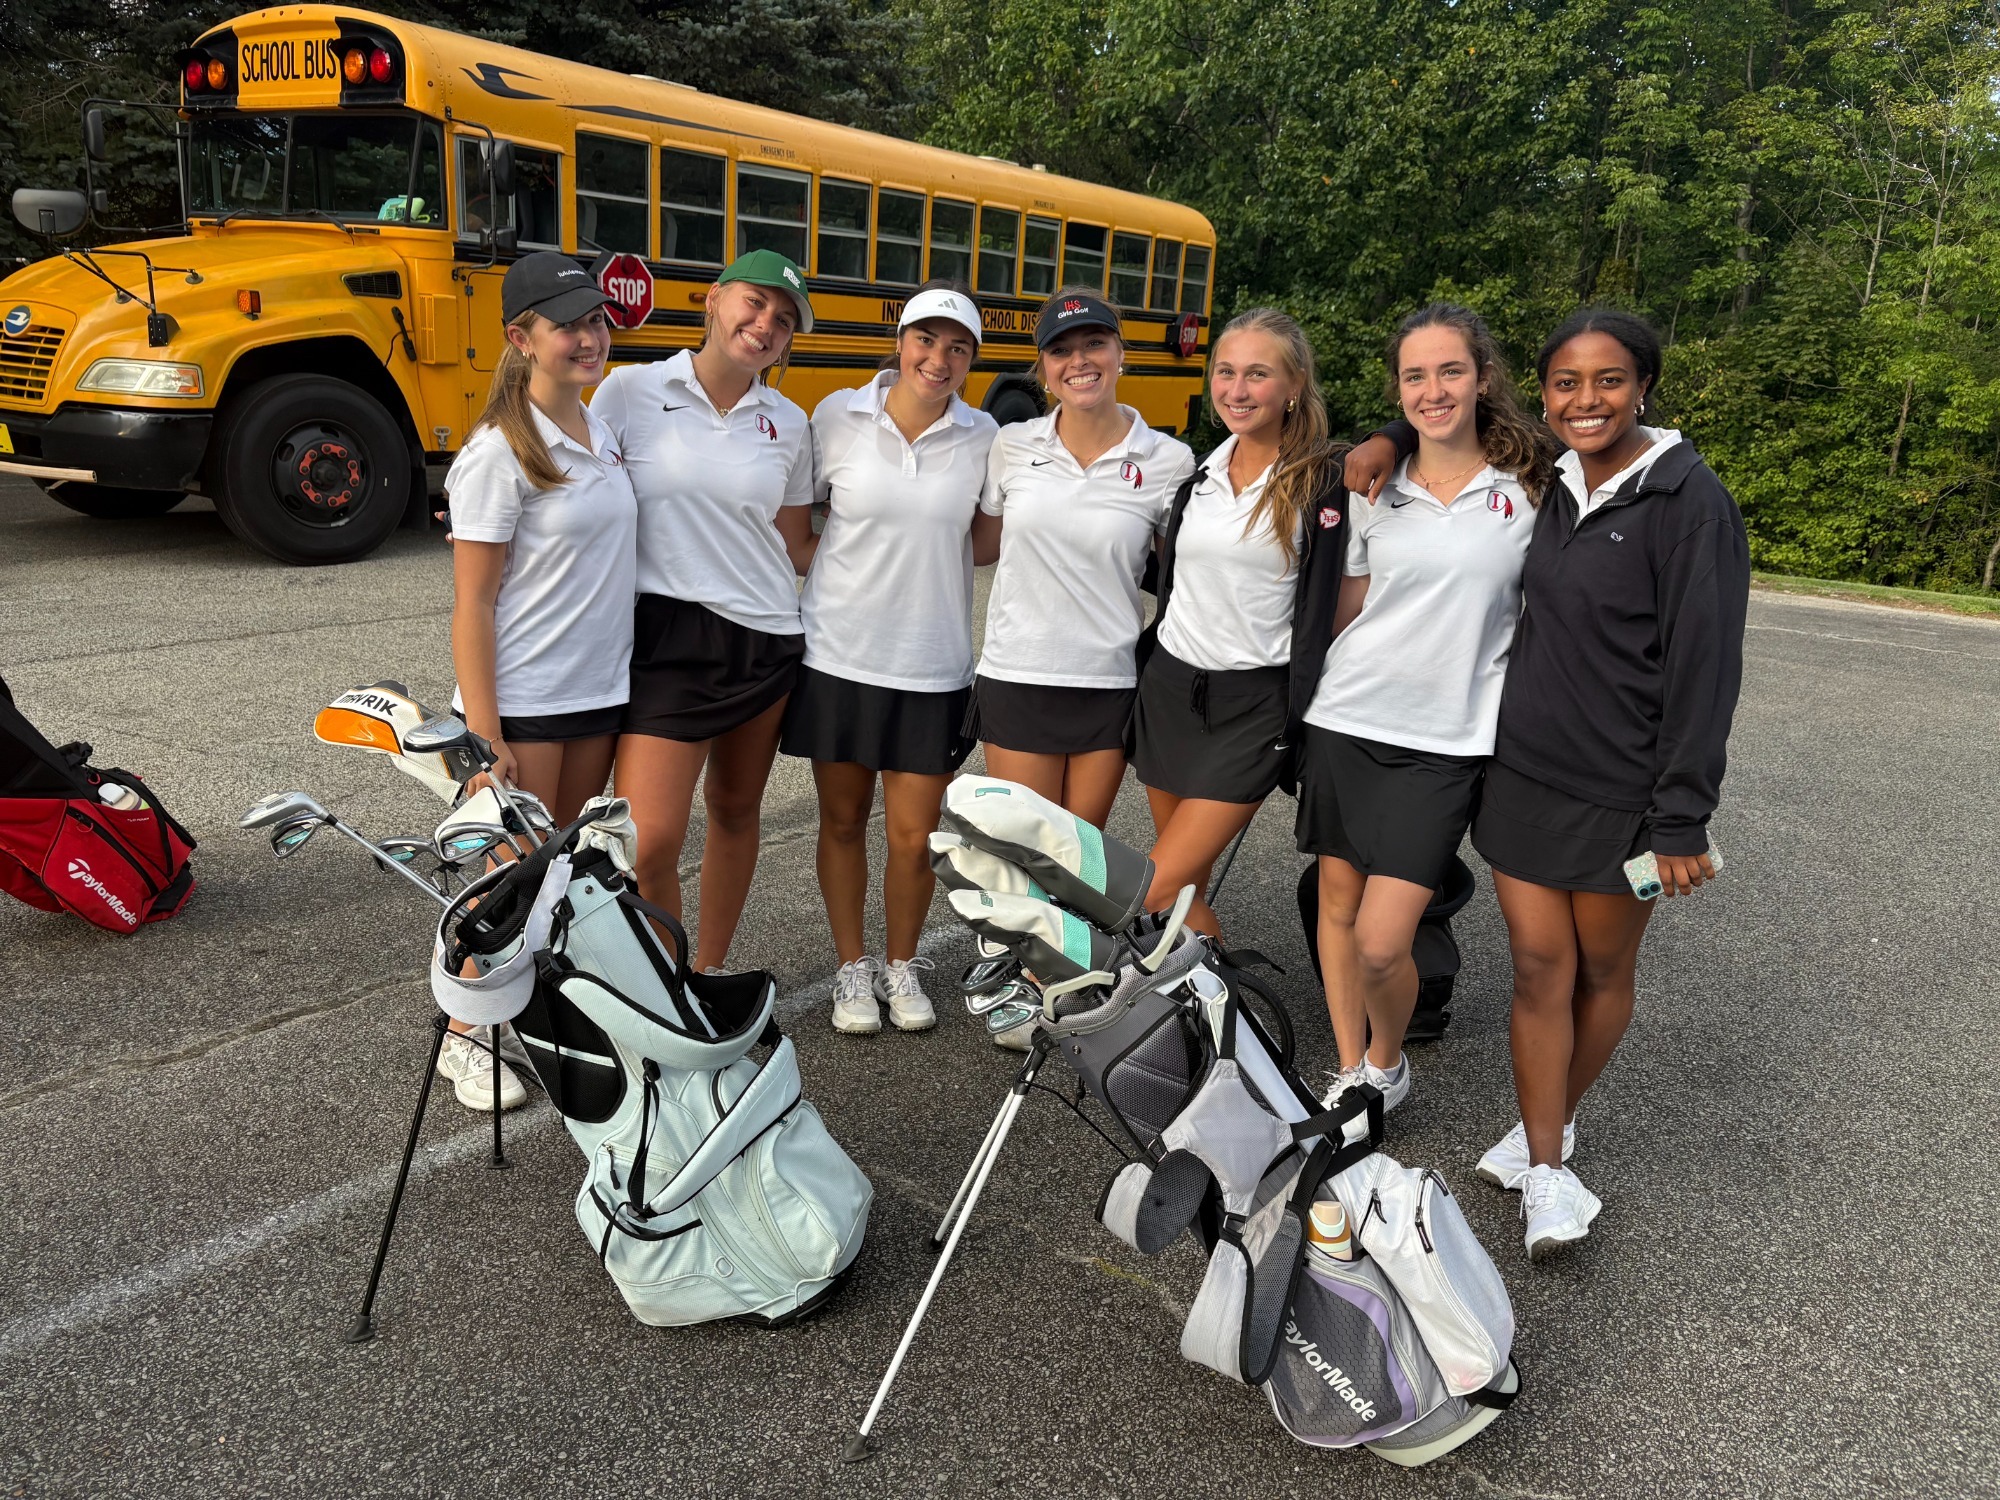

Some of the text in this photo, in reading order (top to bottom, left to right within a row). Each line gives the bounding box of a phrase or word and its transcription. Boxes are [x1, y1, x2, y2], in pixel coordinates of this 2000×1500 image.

[242, 38, 336, 82] SCHOOL BUS
[608, 276, 647, 306] STOP
[882, 300, 1038, 331] IND CHOOL DIS
[1057, 310, 1073, 319] Girls
[1064, 300, 1081, 311] IHS
[1183, 327, 1198, 344] STOP
[1323, 513, 1340, 523] IHS
[337, 694, 398, 716] MAVRIK
[68, 858, 137, 926] TaylorMade
[1285, 1306, 1377, 1422] aylorMade
